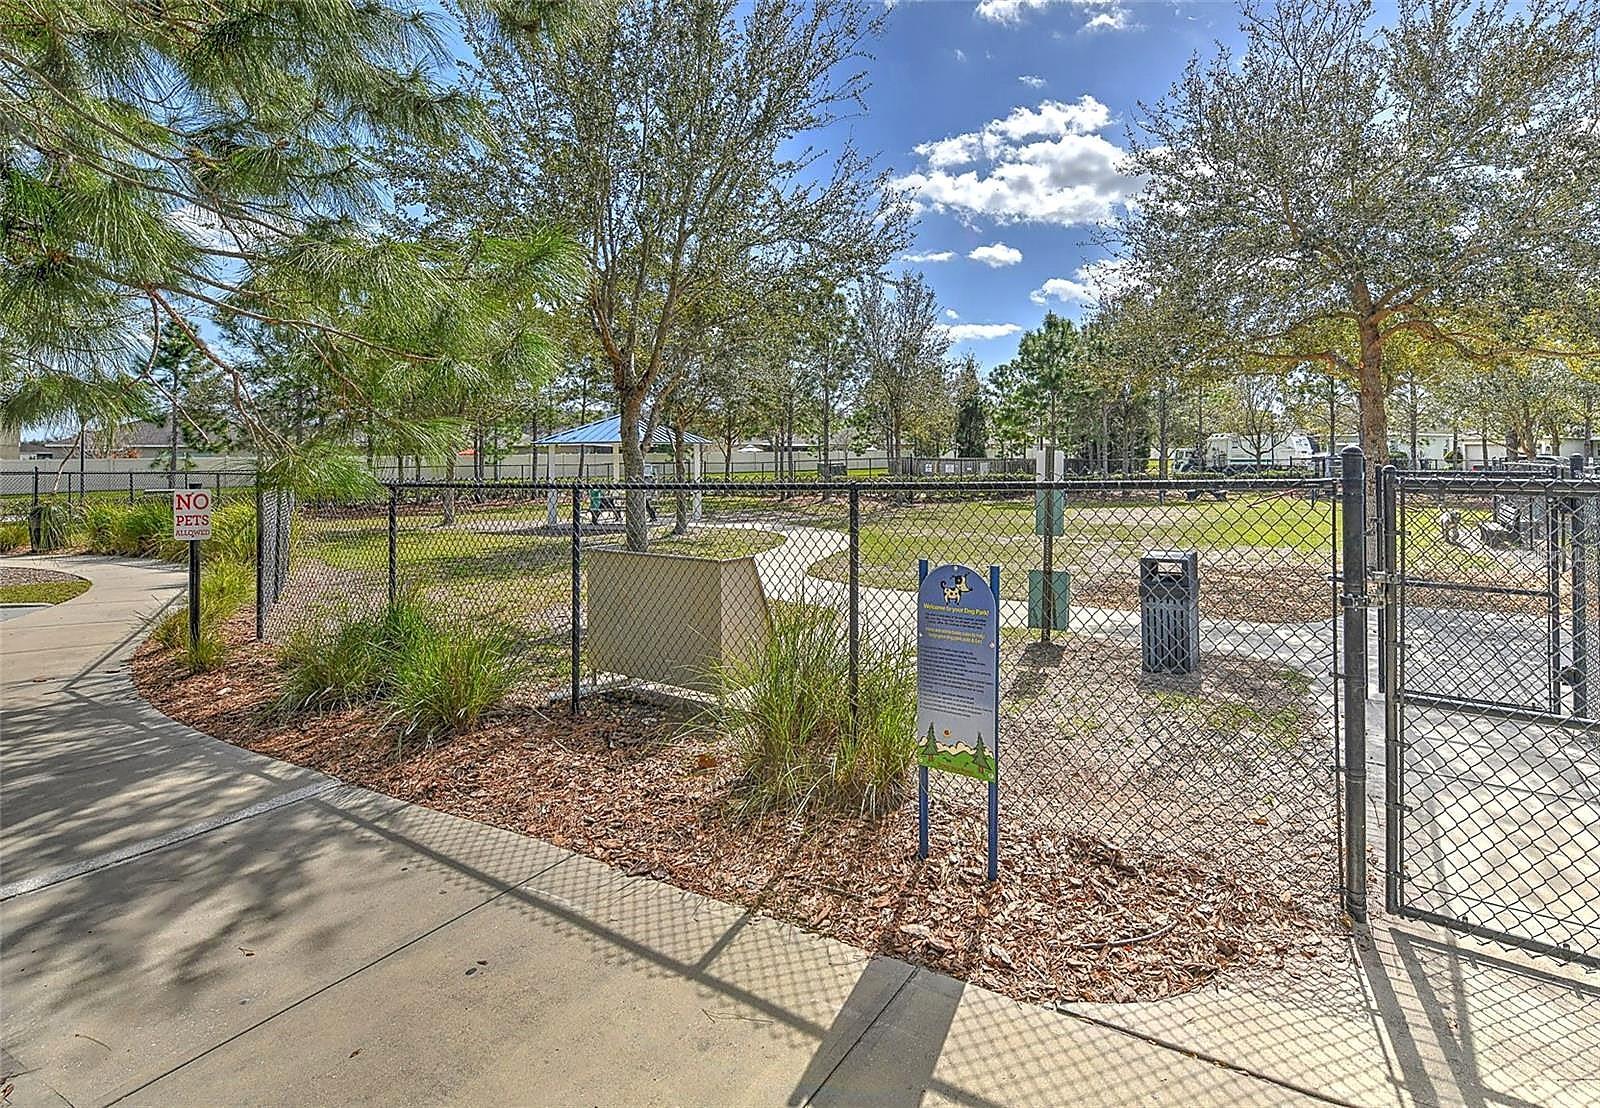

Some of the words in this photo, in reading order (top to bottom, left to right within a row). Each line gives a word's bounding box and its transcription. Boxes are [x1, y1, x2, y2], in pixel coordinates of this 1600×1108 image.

[176, 493, 209, 510] NO
[176, 515, 209, 526] PETS
[924, 603, 945, 611] Welcome
